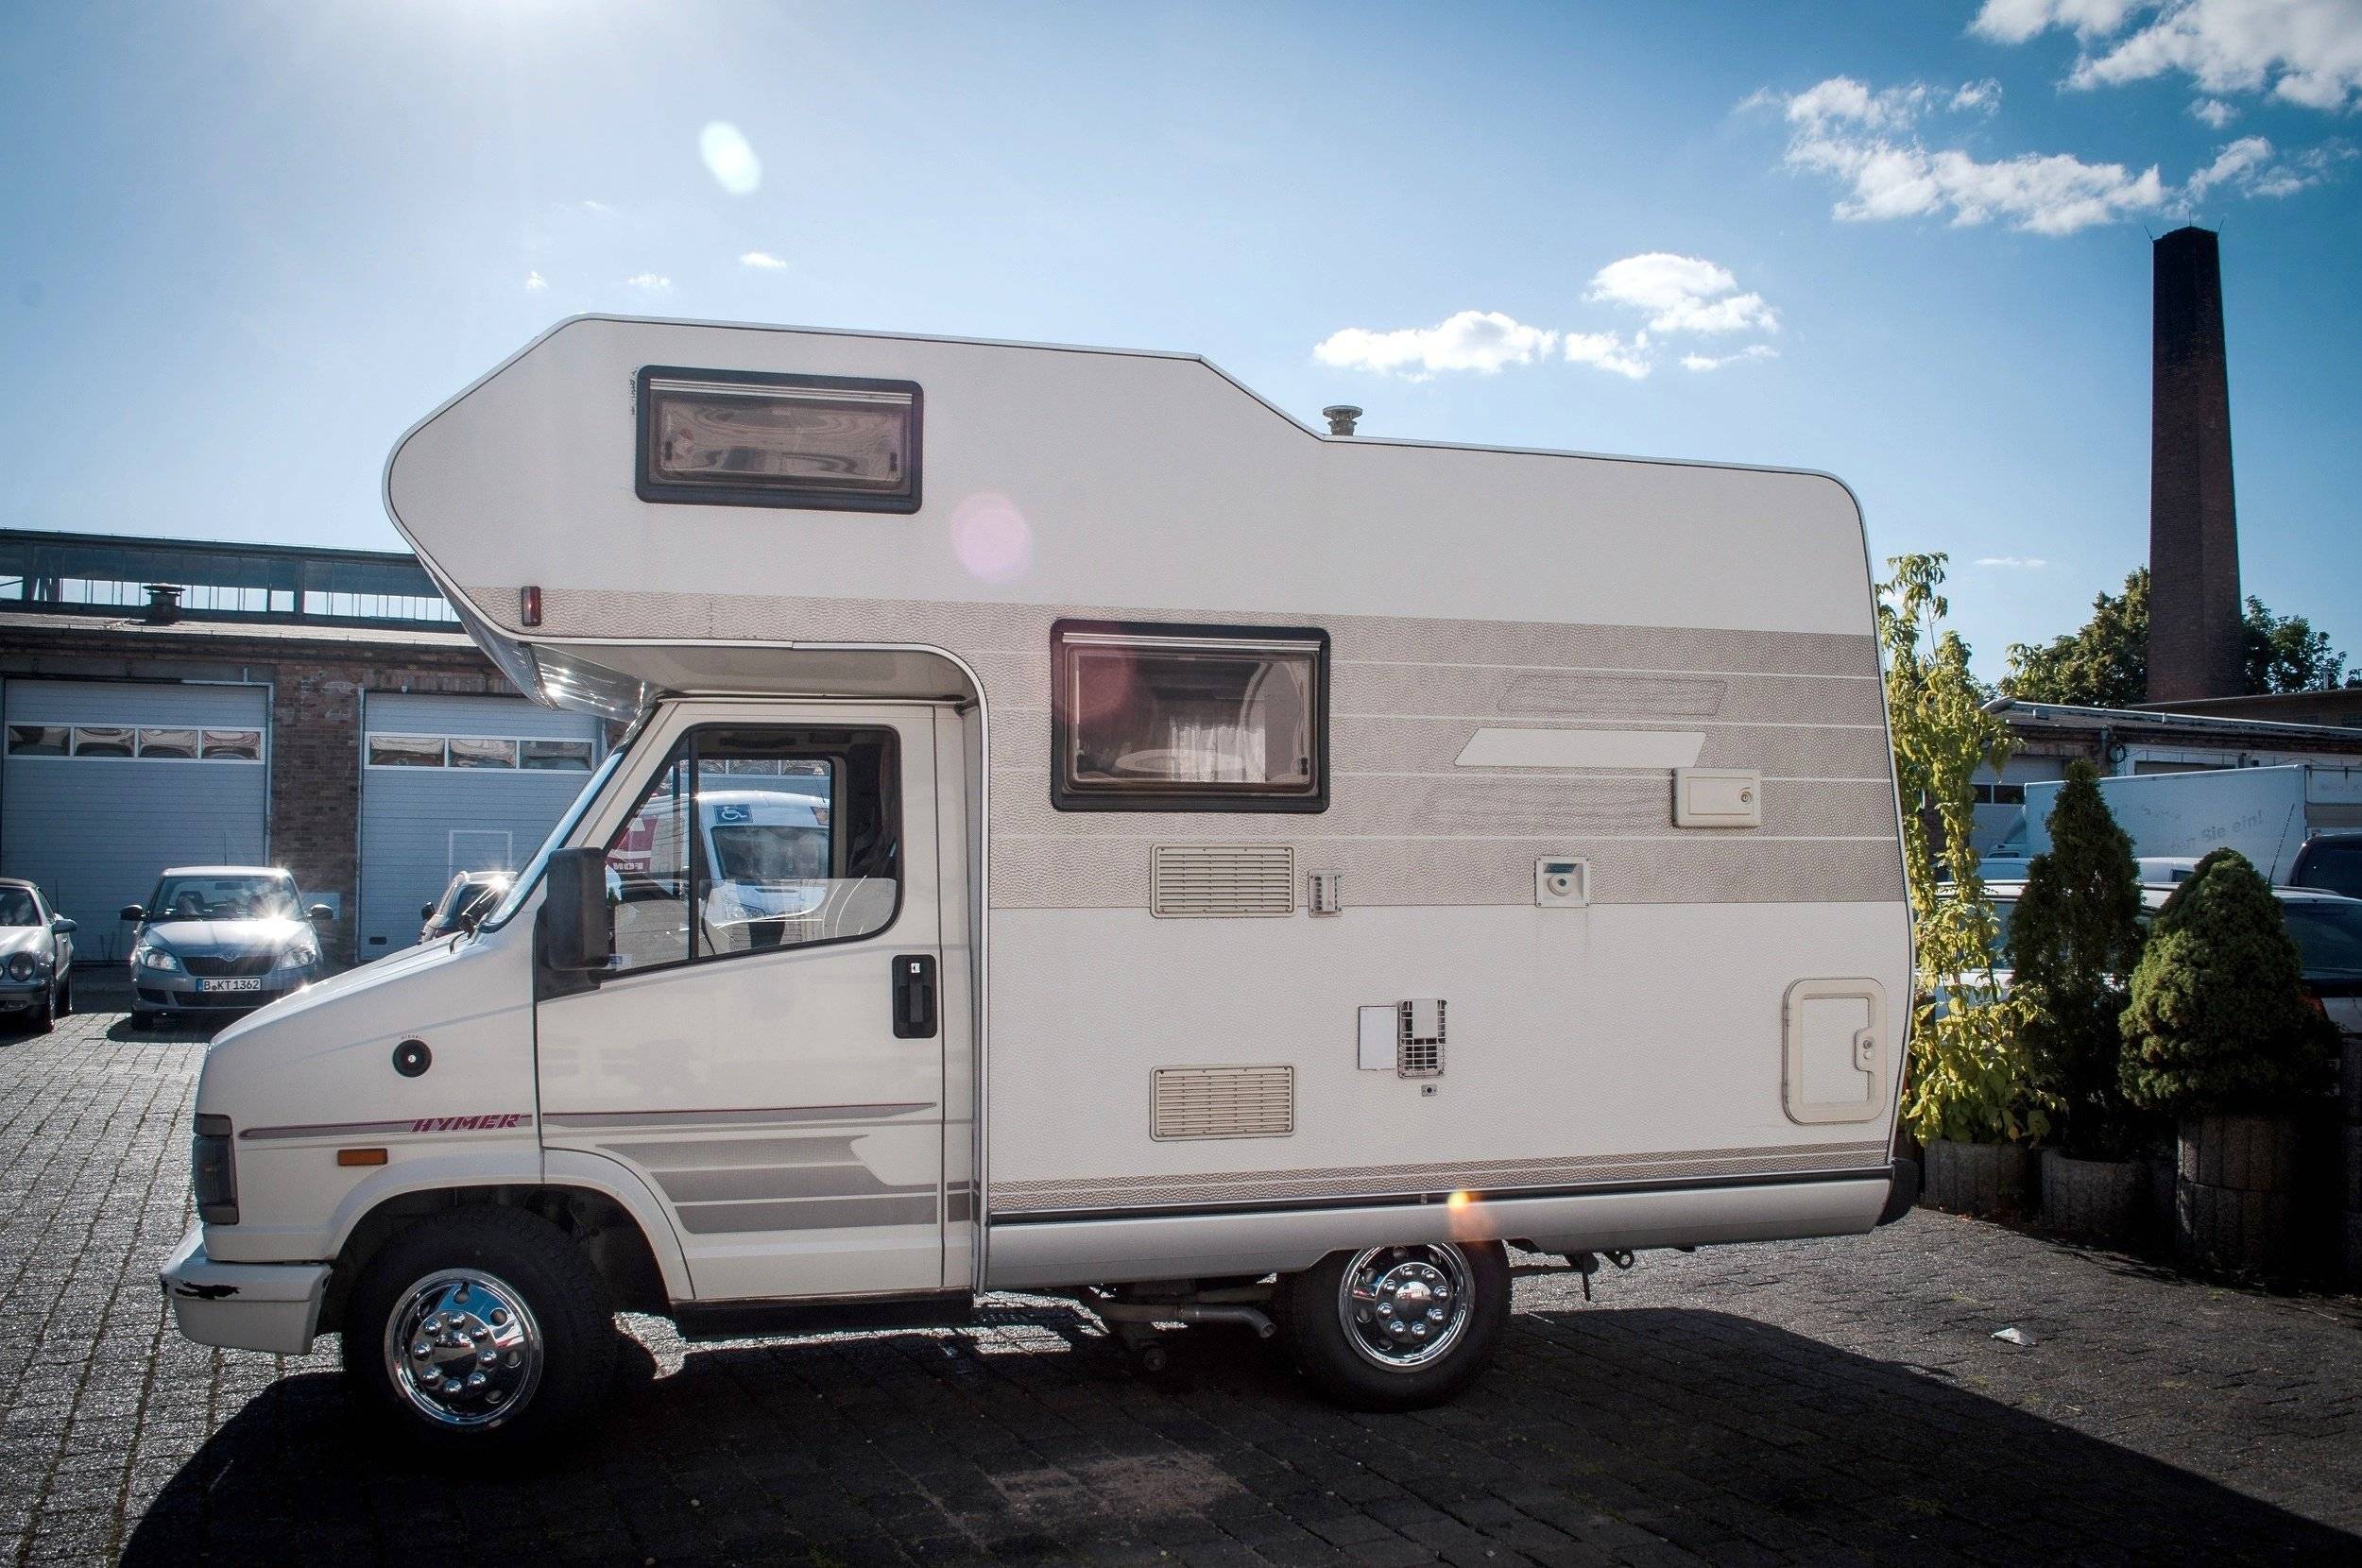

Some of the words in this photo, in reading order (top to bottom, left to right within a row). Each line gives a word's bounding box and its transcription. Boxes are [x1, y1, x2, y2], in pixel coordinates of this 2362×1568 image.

[2201, 825, 2226, 842] Sie
[203, 980, 211, 990] B
[232, 980, 260, 989] 1362
[411, 1114, 522, 1133] HYMER
